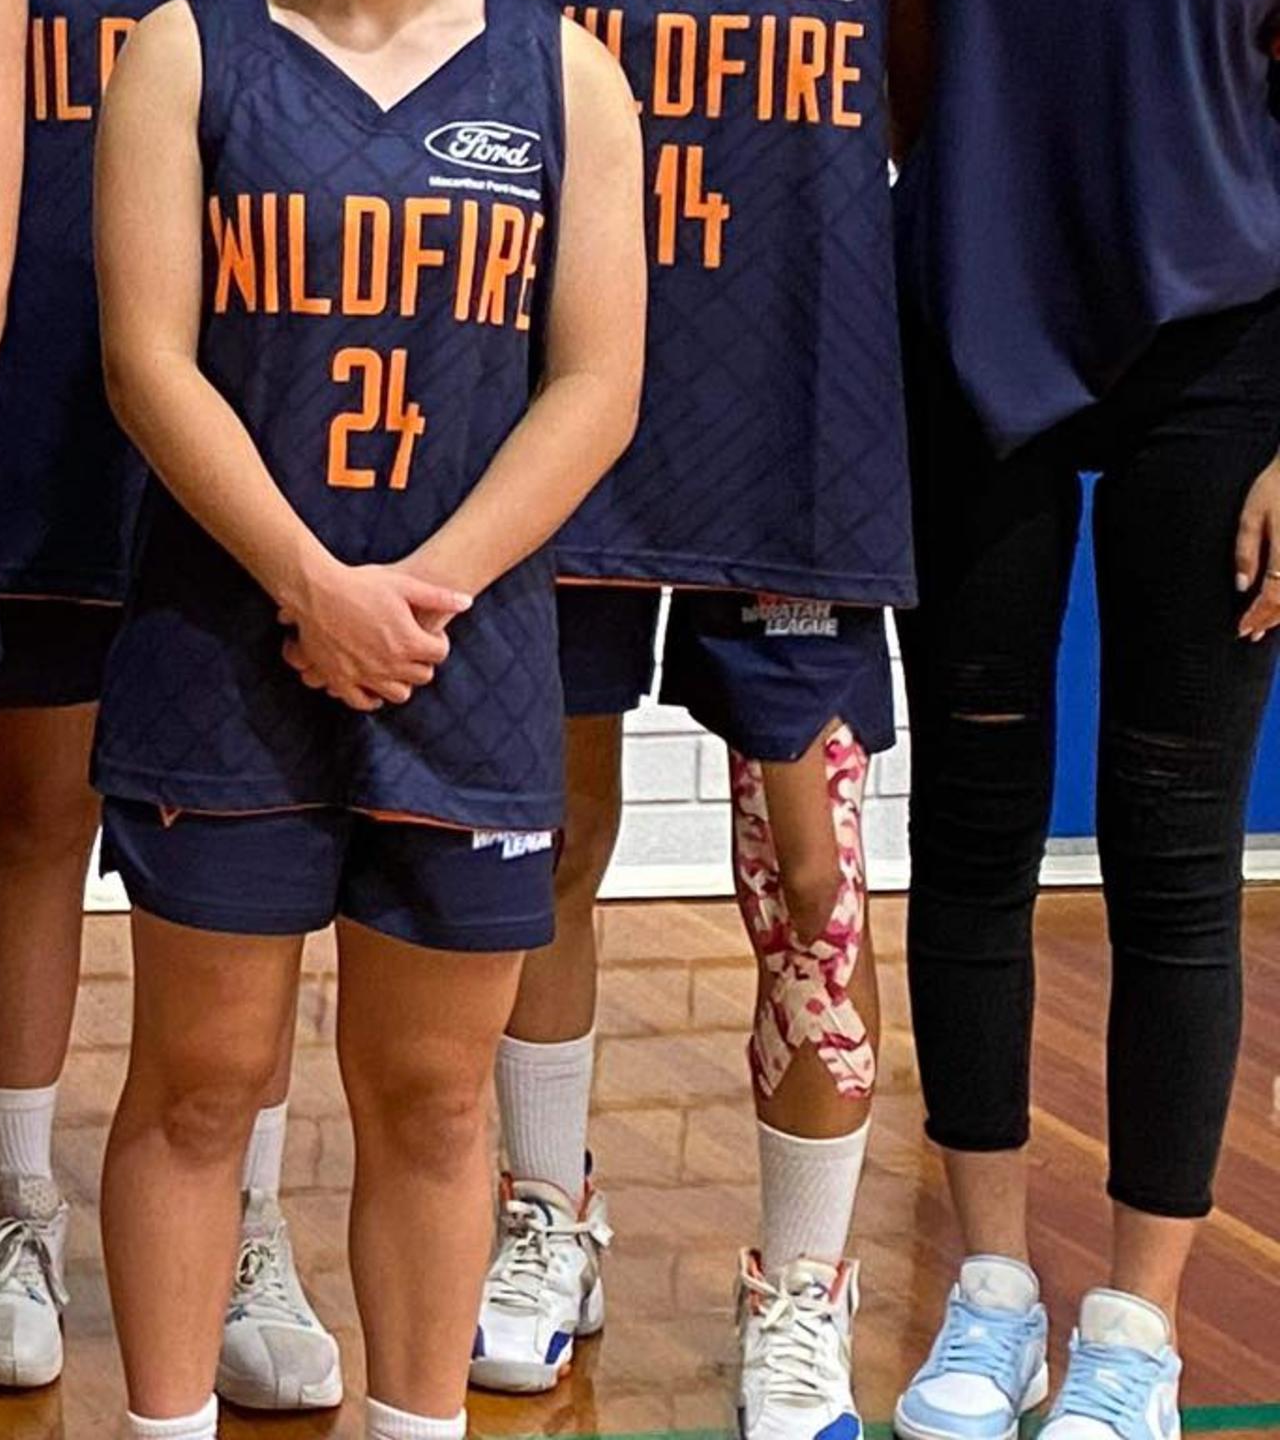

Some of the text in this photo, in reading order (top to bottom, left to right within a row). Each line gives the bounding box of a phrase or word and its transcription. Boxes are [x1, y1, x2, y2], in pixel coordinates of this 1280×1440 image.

[562, 5, 866, 127] DFIRE
[448, 127, 531, 167] Ford
[653, 144, 730, 269] 14
[208, 191, 545, 331] WILDFIRE
[327, 346, 427, 490] 24
